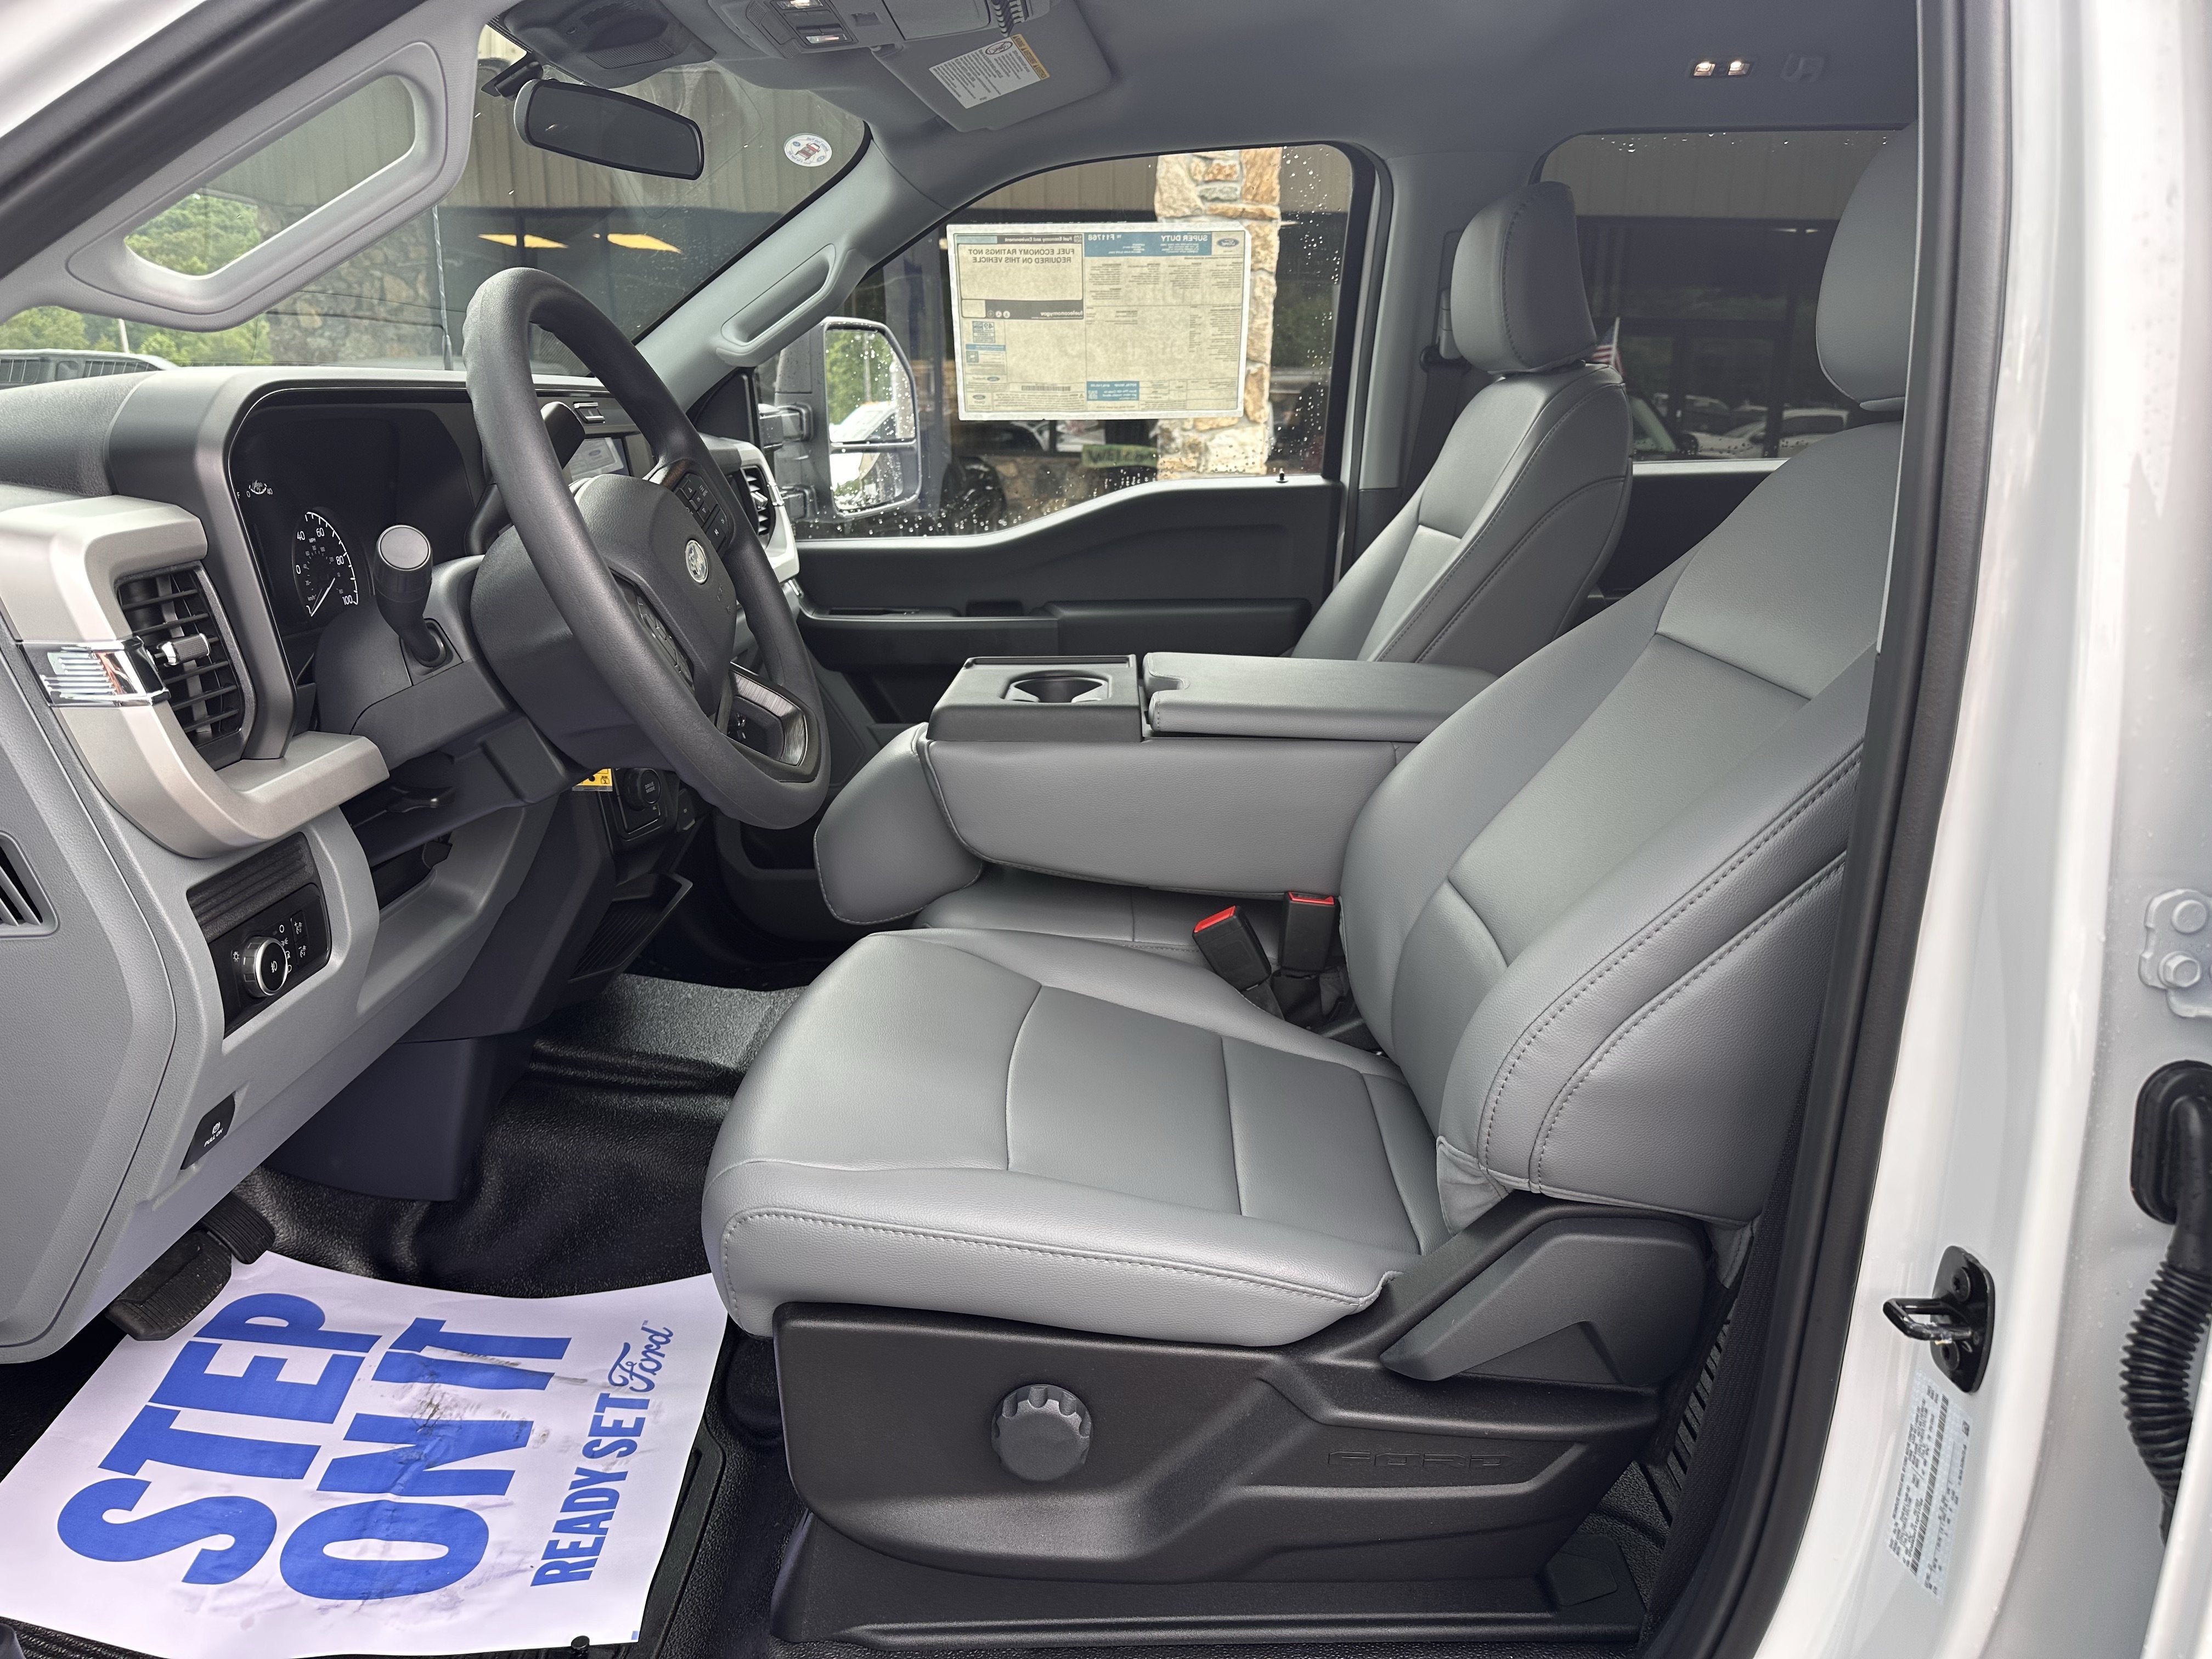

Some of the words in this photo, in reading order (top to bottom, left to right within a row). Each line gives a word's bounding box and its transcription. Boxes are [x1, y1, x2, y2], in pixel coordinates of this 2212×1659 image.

[296, 531, 306, 541] 40
[316, 528, 325, 538] 60
[336, 555, 345, 566] 80
[343, 595, 353, 605] 100
[372, 1317, 571, 1391] IT
[57, 1293, 382, 1585] STEP
[1328, 1451, 1516, 1467] FORD
[531, 1470, 629, 1586] READY
[583, 1392, 651, 1459] SET
[280, 1413, 534, 1600] ON
